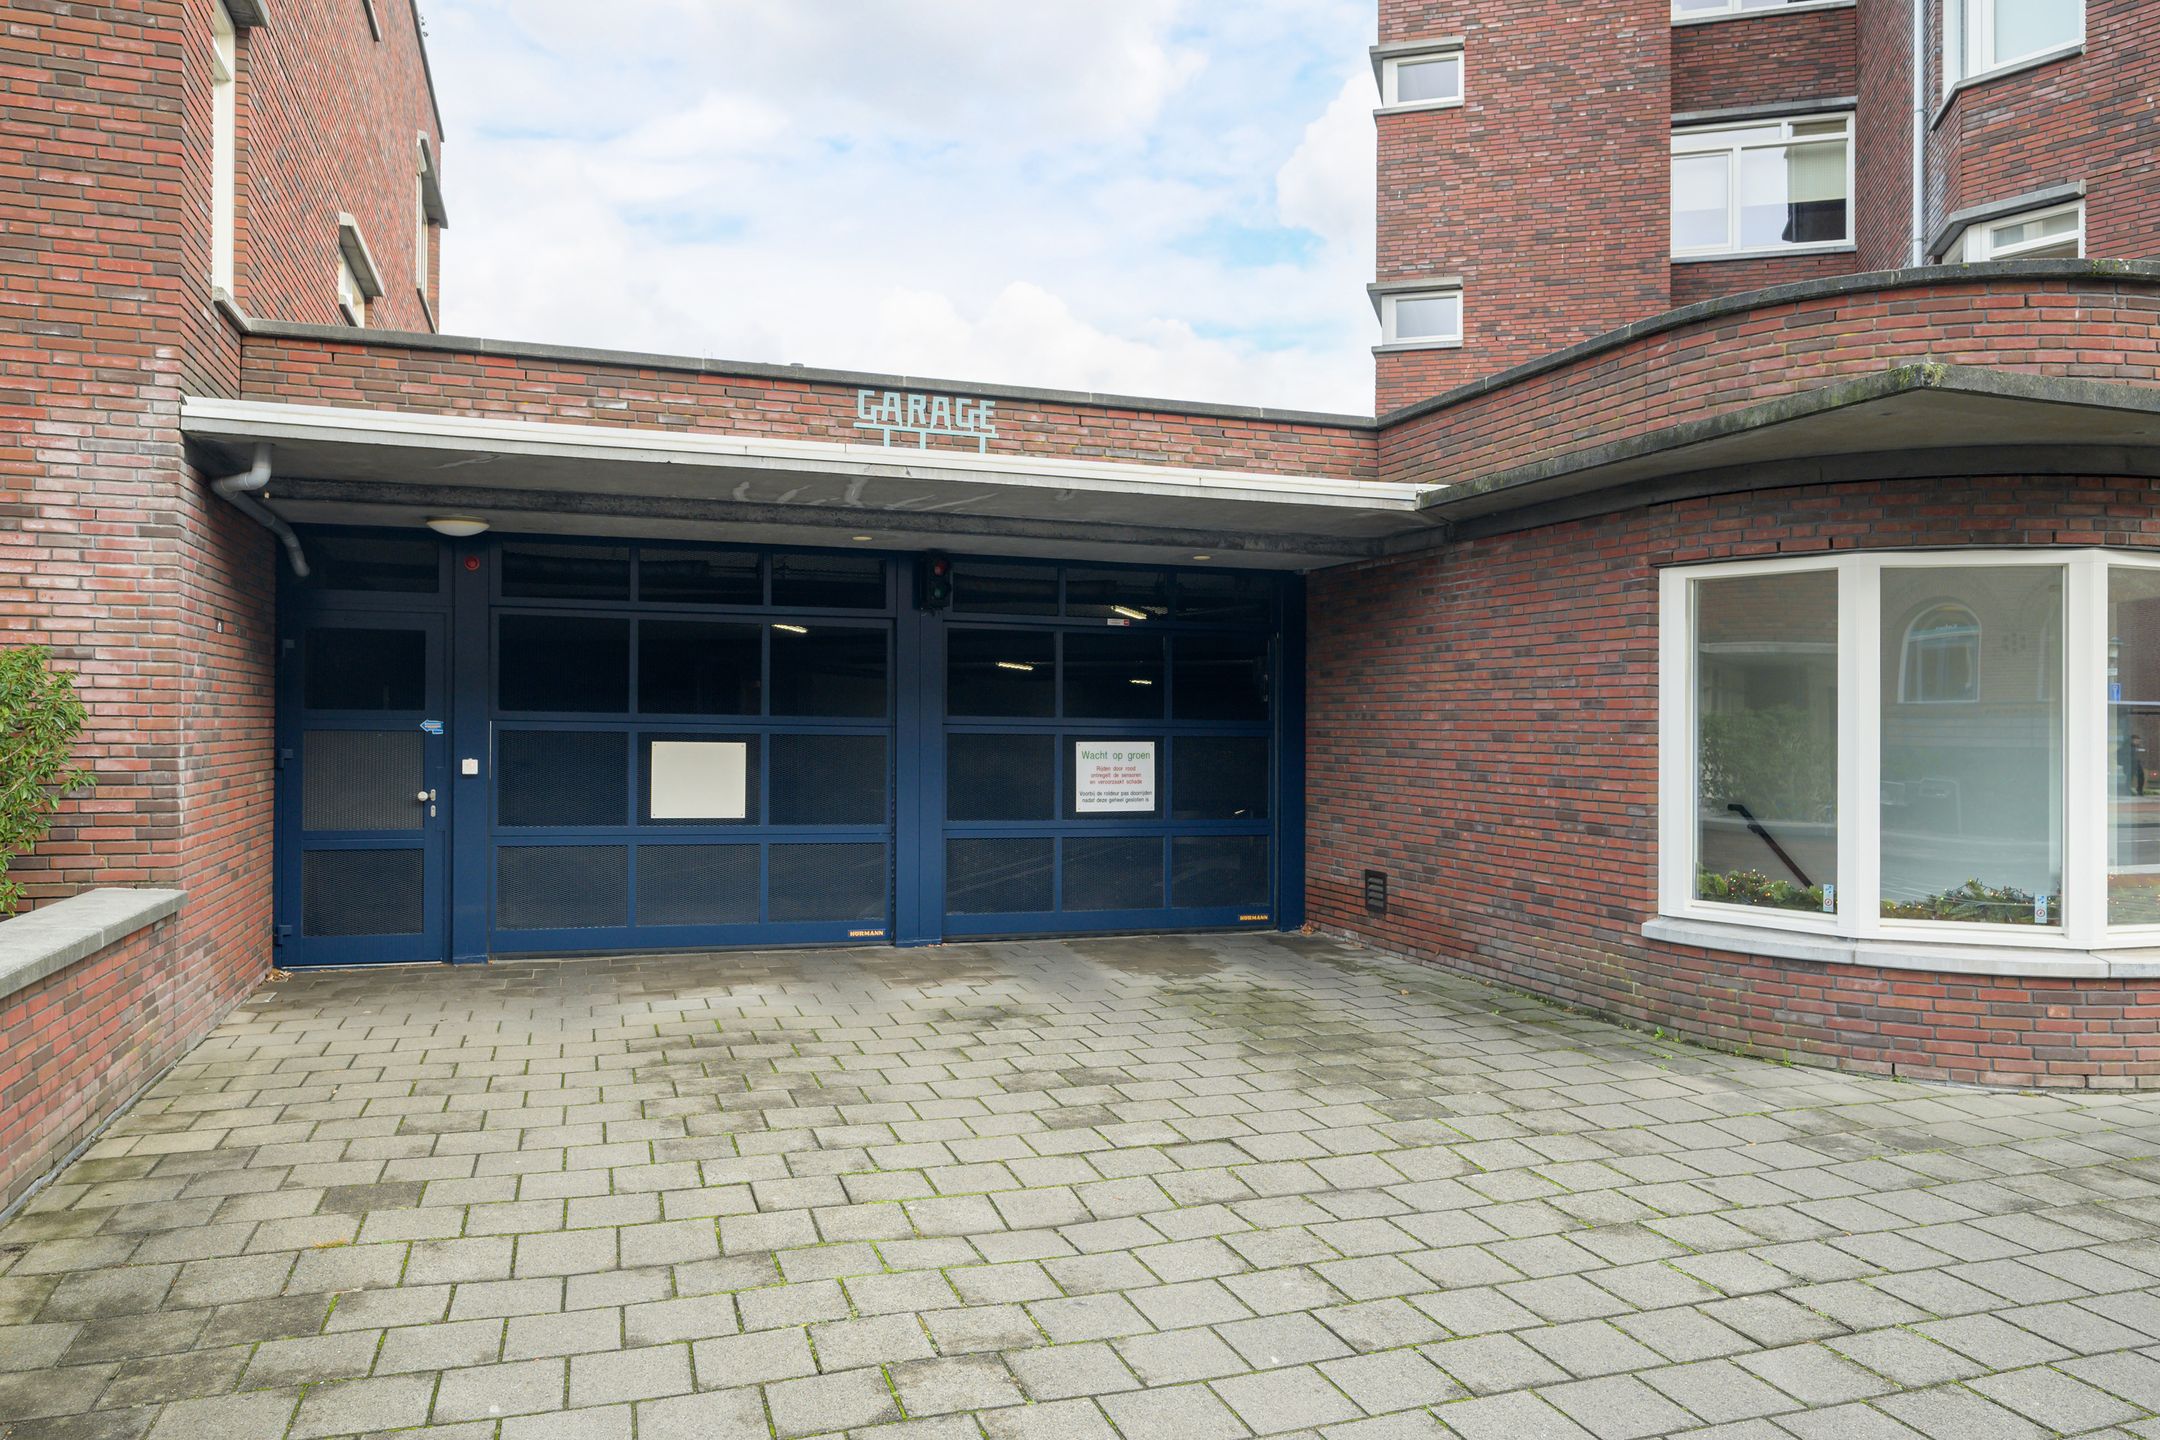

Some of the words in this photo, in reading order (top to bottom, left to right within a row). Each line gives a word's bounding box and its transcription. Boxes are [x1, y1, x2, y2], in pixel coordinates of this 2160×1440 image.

[857, 389, 996, 434] GARAGE
[1081, 750, 1108, 760] Wacht
[1112, 752, 1123, 762] op
[1127, 752, 1151, 762] groen
